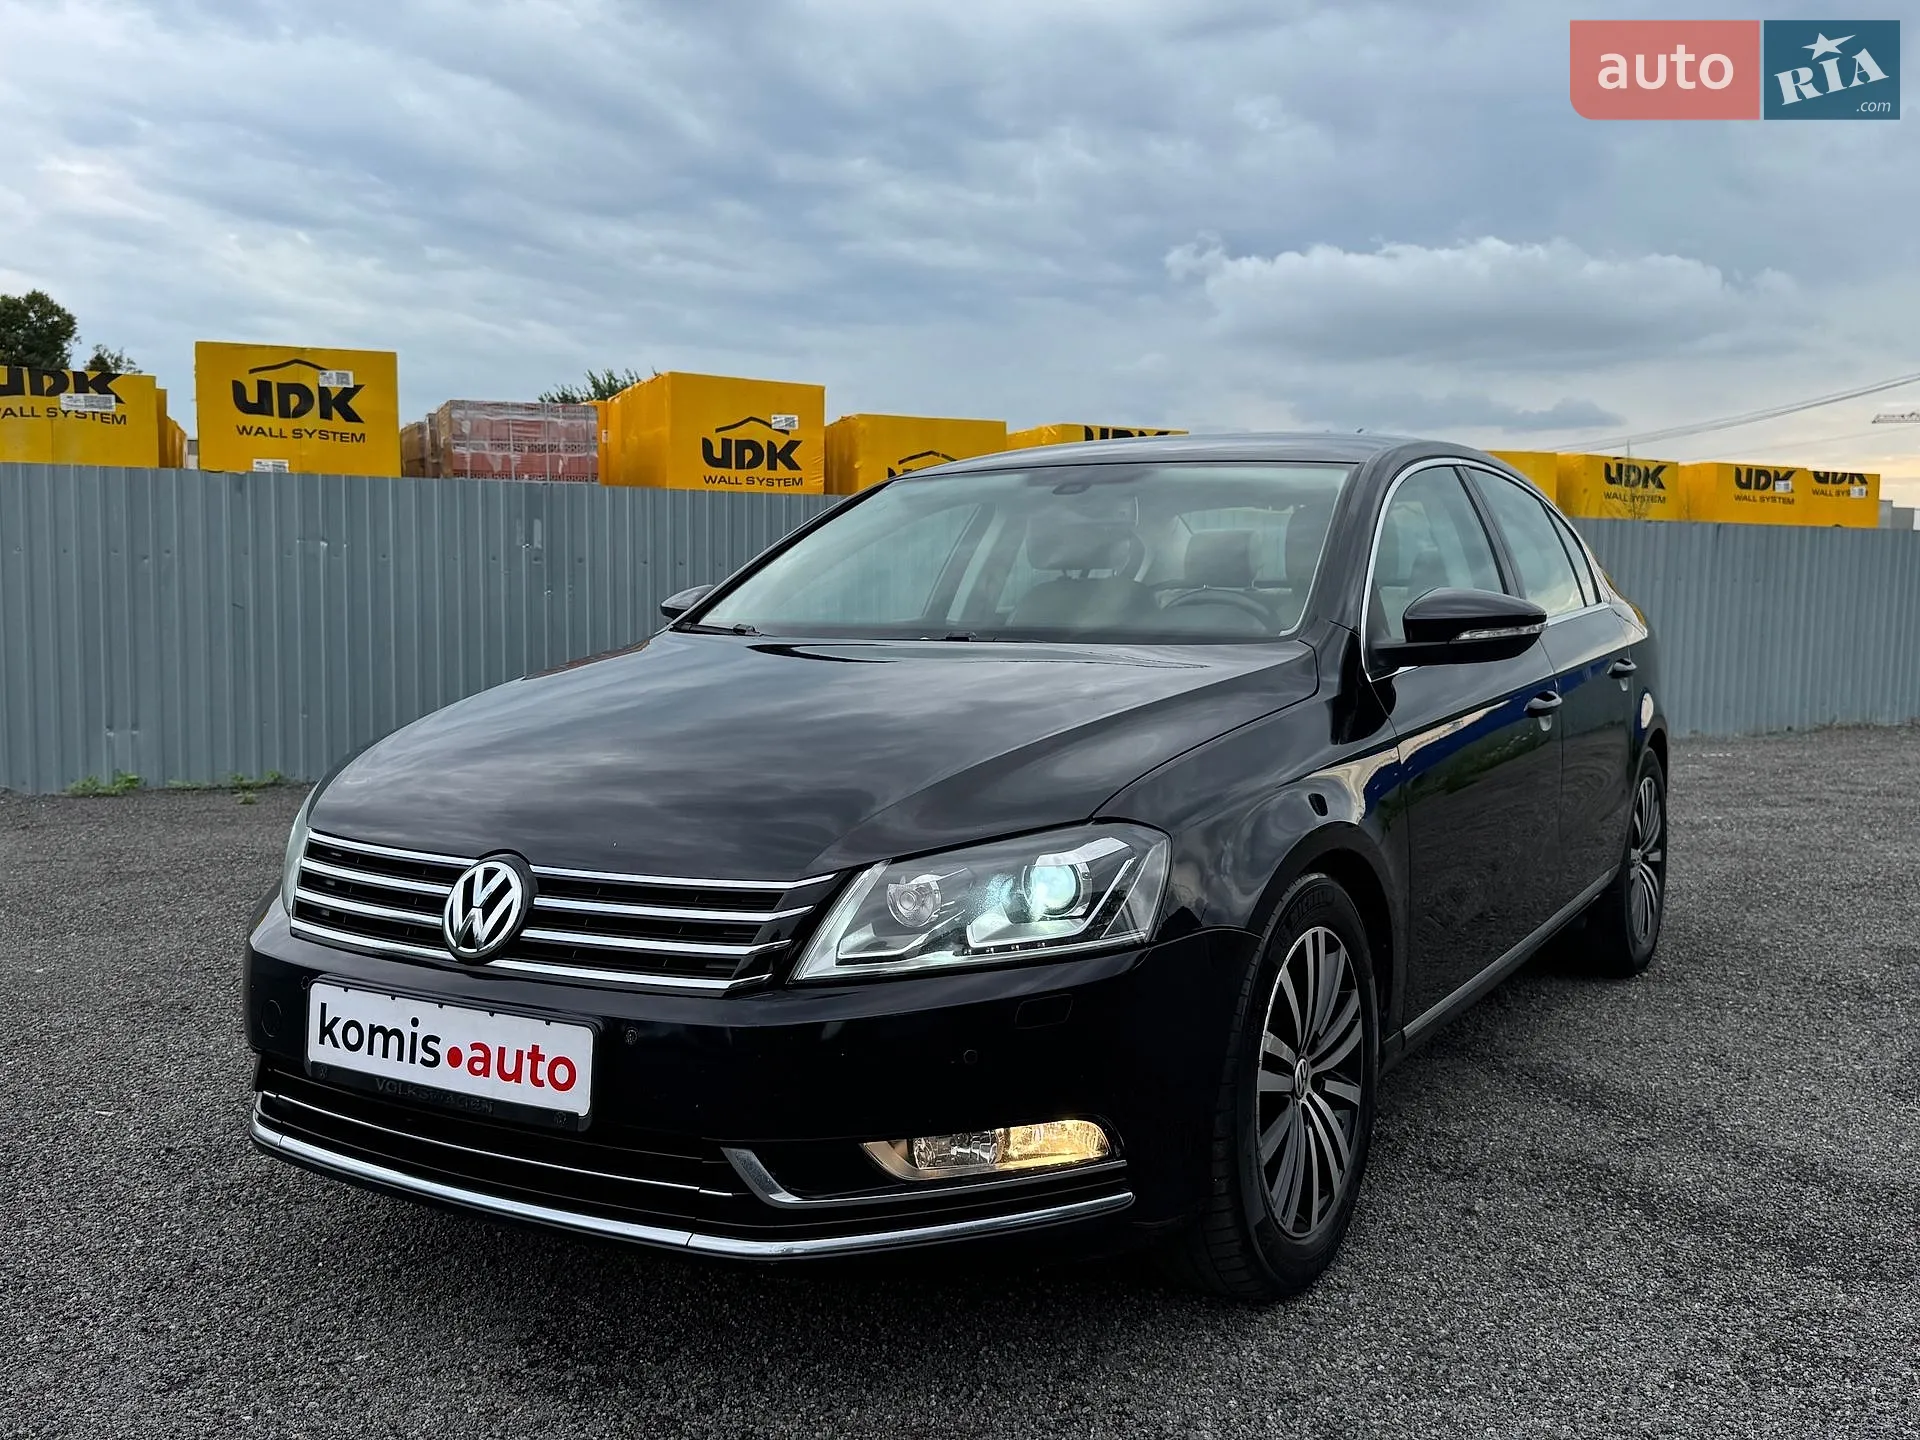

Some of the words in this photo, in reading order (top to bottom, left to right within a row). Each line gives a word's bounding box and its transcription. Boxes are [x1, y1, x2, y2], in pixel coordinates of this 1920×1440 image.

[231, 379, 366, 424] UDK
[0, 406, 41, 420] ALL
[236, 425, 288, 439] WALL
[292, 428, 366, 443] SYSTEM
[701, 437, 804, 471] UDK
[703, 475, 742, 486] WALL
[745, 476, 804, 488] SYSTEM
[1604, 462, 1668, 490] UDK
[1734, 466, 1796, 493] UDK
[1603, 491, 1629, 503] WALL
[1734, 494, 1759, 503] WALL
[1759, 495, 1795, 505] SYSTEM
[1812, 488, 1834, 497] WALL
